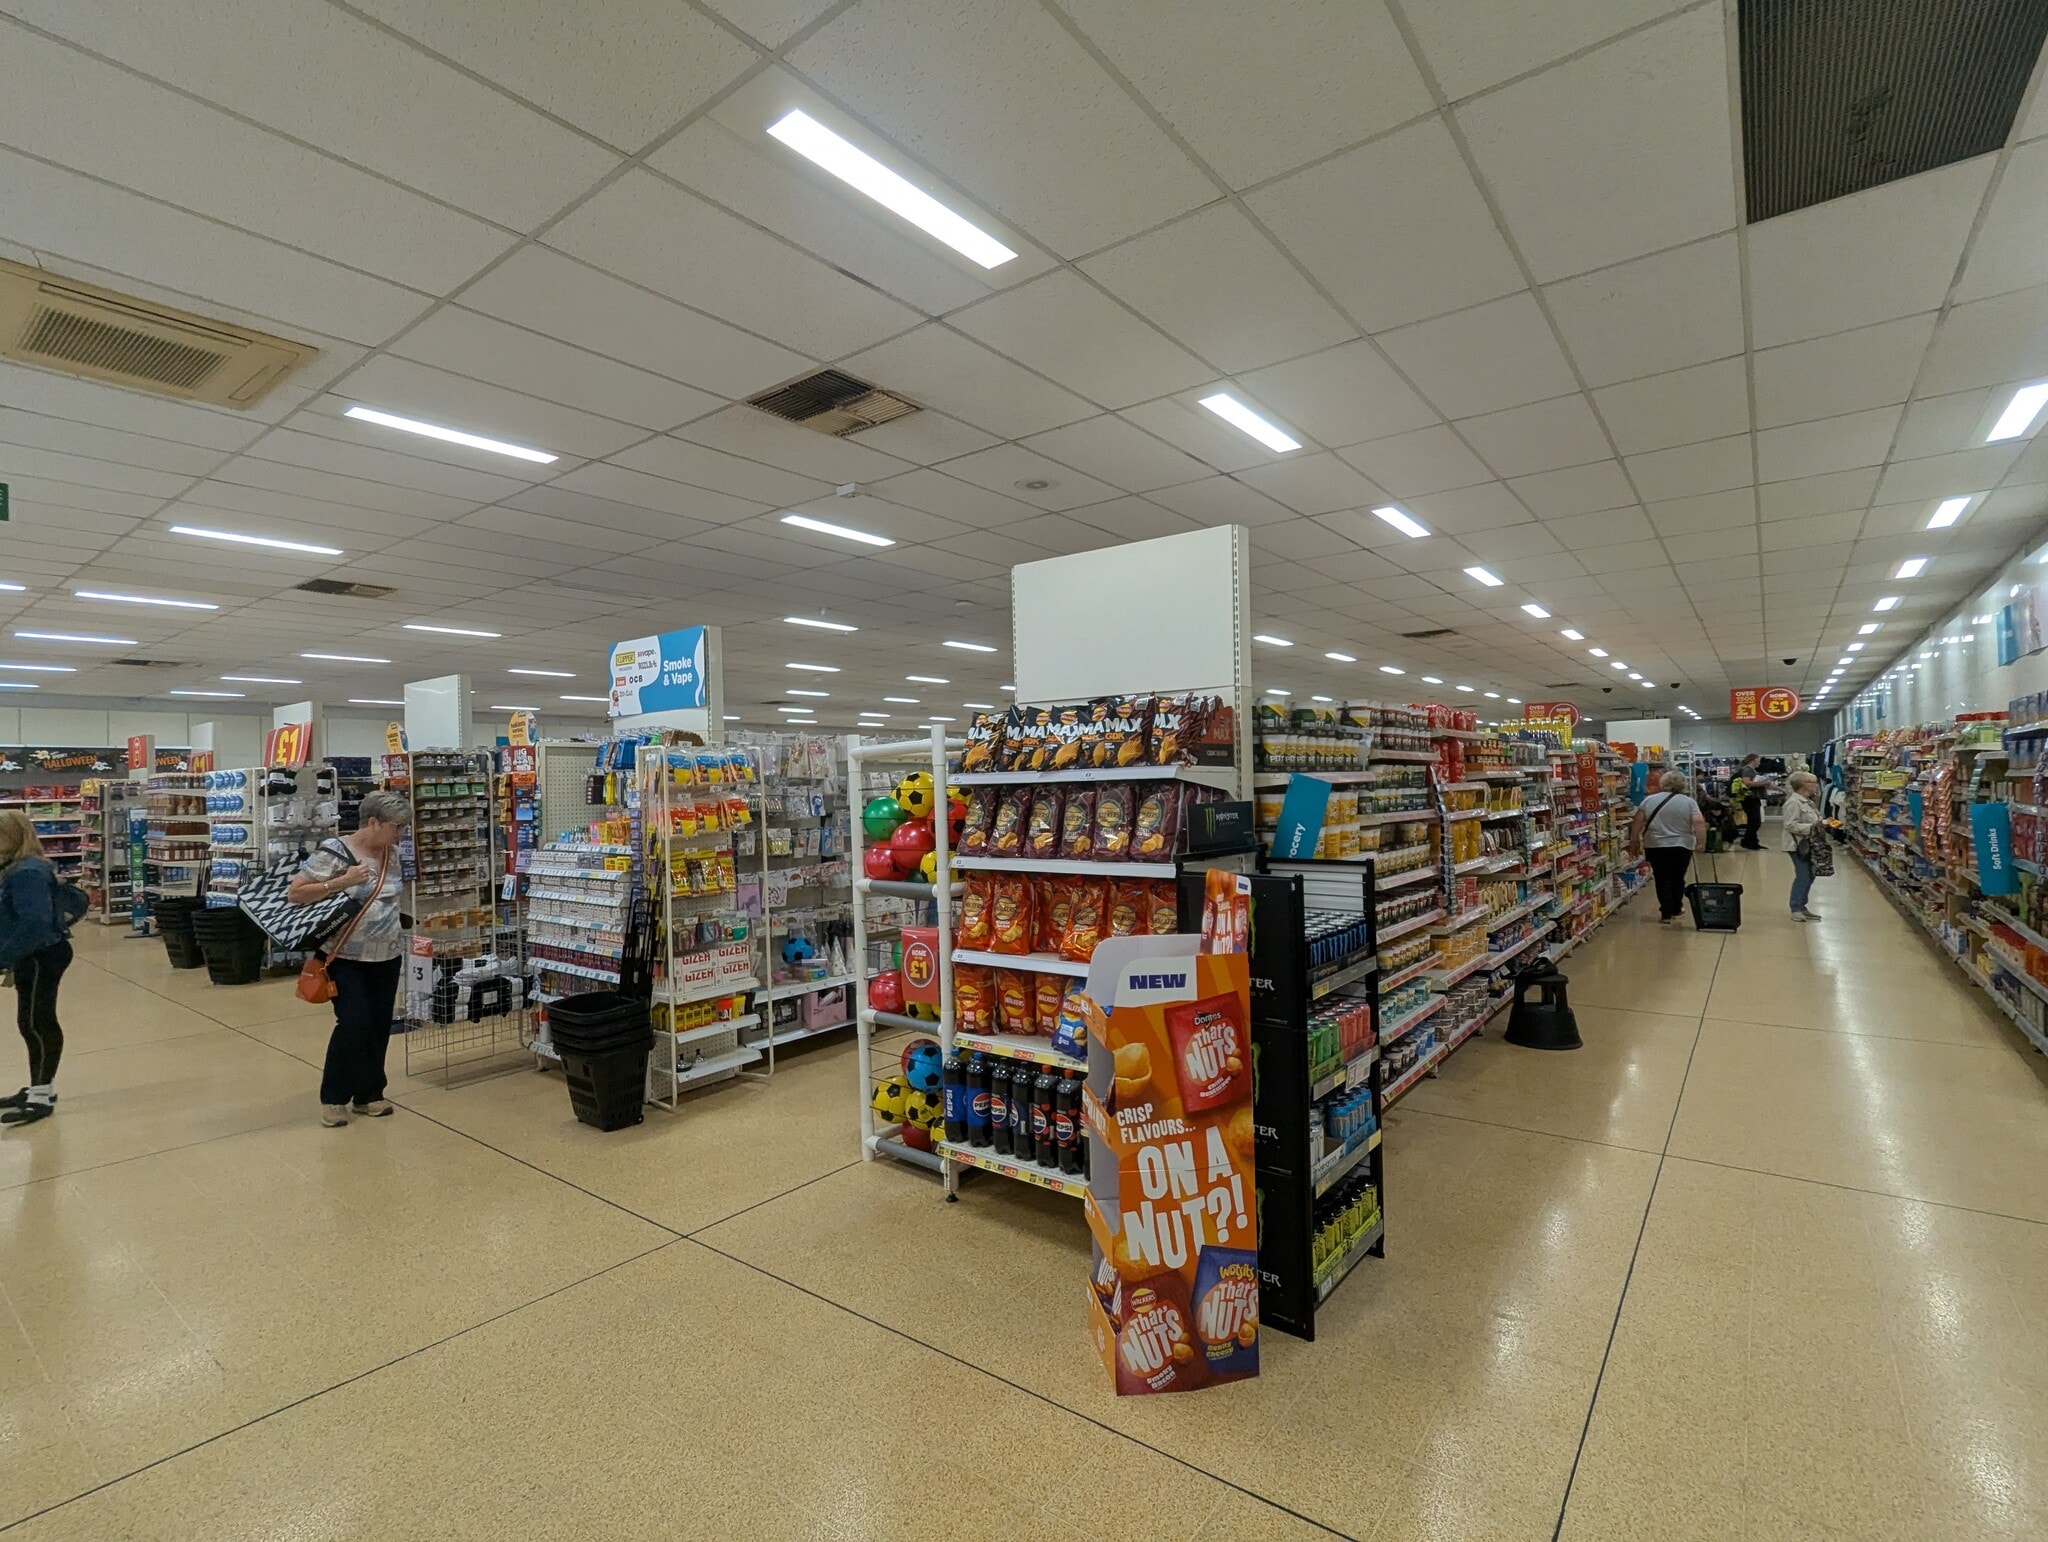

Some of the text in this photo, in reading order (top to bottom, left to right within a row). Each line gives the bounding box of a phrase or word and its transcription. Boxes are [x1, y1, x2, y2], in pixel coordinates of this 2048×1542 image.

[663, 656, 692, 672] Smoke
[629, 675, 643, 683] OCB
[663, 672, 693, 686] & Vape
[1736, 704, 1756, 716] £1
[1768, 700, 1789, 713] £1
[1106, 718, 1143, 732] MAX
[1213, 728, 1230, 740] MAX
[276, 729, 299, 766] £1
[44, 755, 97, 769] HALLOWEEN
[1289, 822, 1306, 858] rocery
[1988, 828, 2001, 869] Soft Drinks
[315, 911, 349, 939] Poundland
[719, 945, 747, 957] GIZEH
[911, 949, 926, 957] HOME
[682, 952, 711, 966] GIZEH
[413, 966, 424, 981] £3
[685, 968, 714, 982] GIZEH
[723, 962, 749, 975] GIZEH
[910, 961, 927, 979] £1
[1130, 974, 1186, 990] NEW
[1005, 997, 1025, 1006] WALKERS
[1038, 994, 1059, 1004] WALKERS
[1063, 1001, 1081, 1012] WALKER
[1194, 1012, 1221, 1026] Doritos
[1195, 1022, 1226, 1047] That's
[1185, 1026, 1236, 1082] NUTS
[1116, 1103, 1153, 1127] CRISP
[1120, 1118, 1196, 1144] FLAVOURS...
[1138, 1126, 1233, 1200] ON A
[1122, 1173, 1248, 1269] NUT?!
[1219, 1281, 1256, 1300] That's
[1131, 1293, 1157, 1307] WALKERS
[1130, 1305, 1168, 1334] That's
[1201, 1288, 1258, 1340] NUTS
[1122, 1309, 1183, 1373] NUTS
[1151, 1371, 1176, 1390] Bacon
